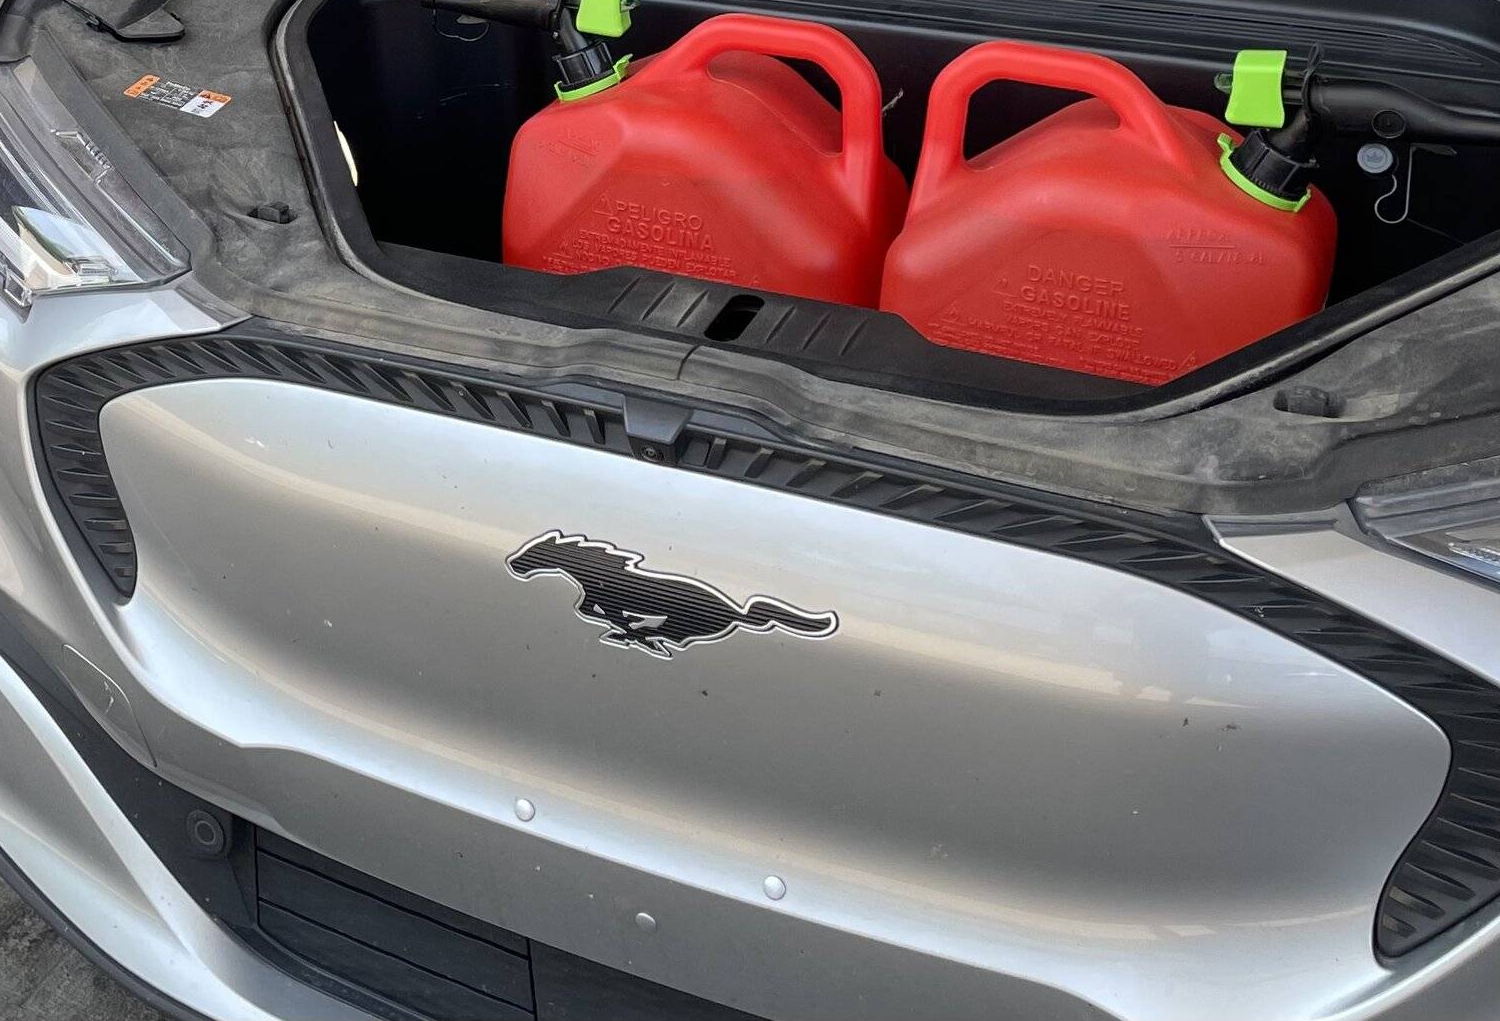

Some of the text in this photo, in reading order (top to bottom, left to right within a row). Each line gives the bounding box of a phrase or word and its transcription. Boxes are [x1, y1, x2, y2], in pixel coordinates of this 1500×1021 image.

[615, 199, 704, 231] PELIGRO
[606, 216, 714, 251] GASOLINA
[1028, 264, 1126, 297] DANGER
[1020, 284, 1131, 321] GASOLINE
